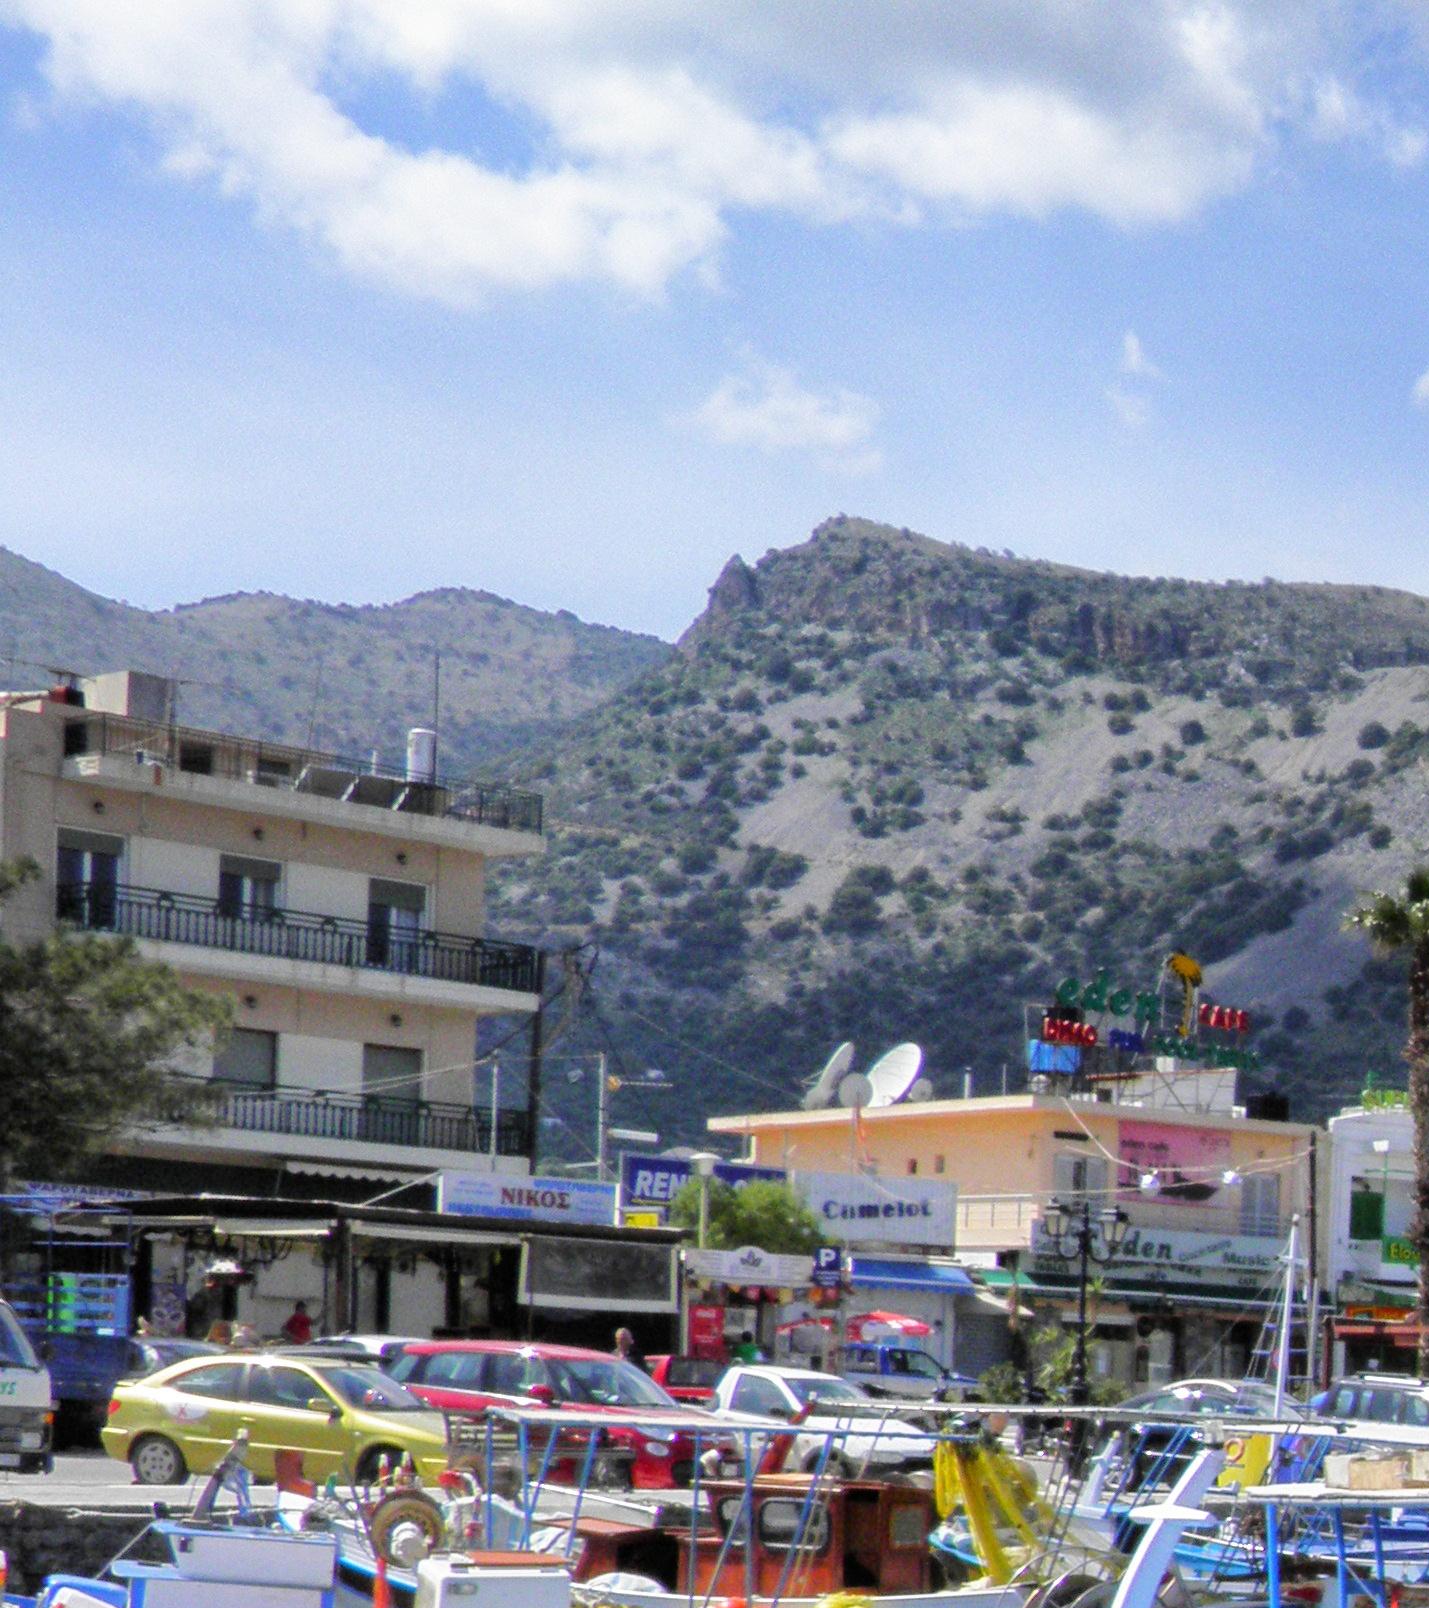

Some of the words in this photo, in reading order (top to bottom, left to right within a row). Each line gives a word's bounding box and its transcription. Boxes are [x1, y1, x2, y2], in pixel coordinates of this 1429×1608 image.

[1056, 966, 1157, 1023] eden
[634, 1170, 690, 1199] REN
[501, 1187, 570, 1209] ΝΙΚΟΣ
[823, 1200, 932, 1219] Camelot
[819, 1248, 835, 1267] P
